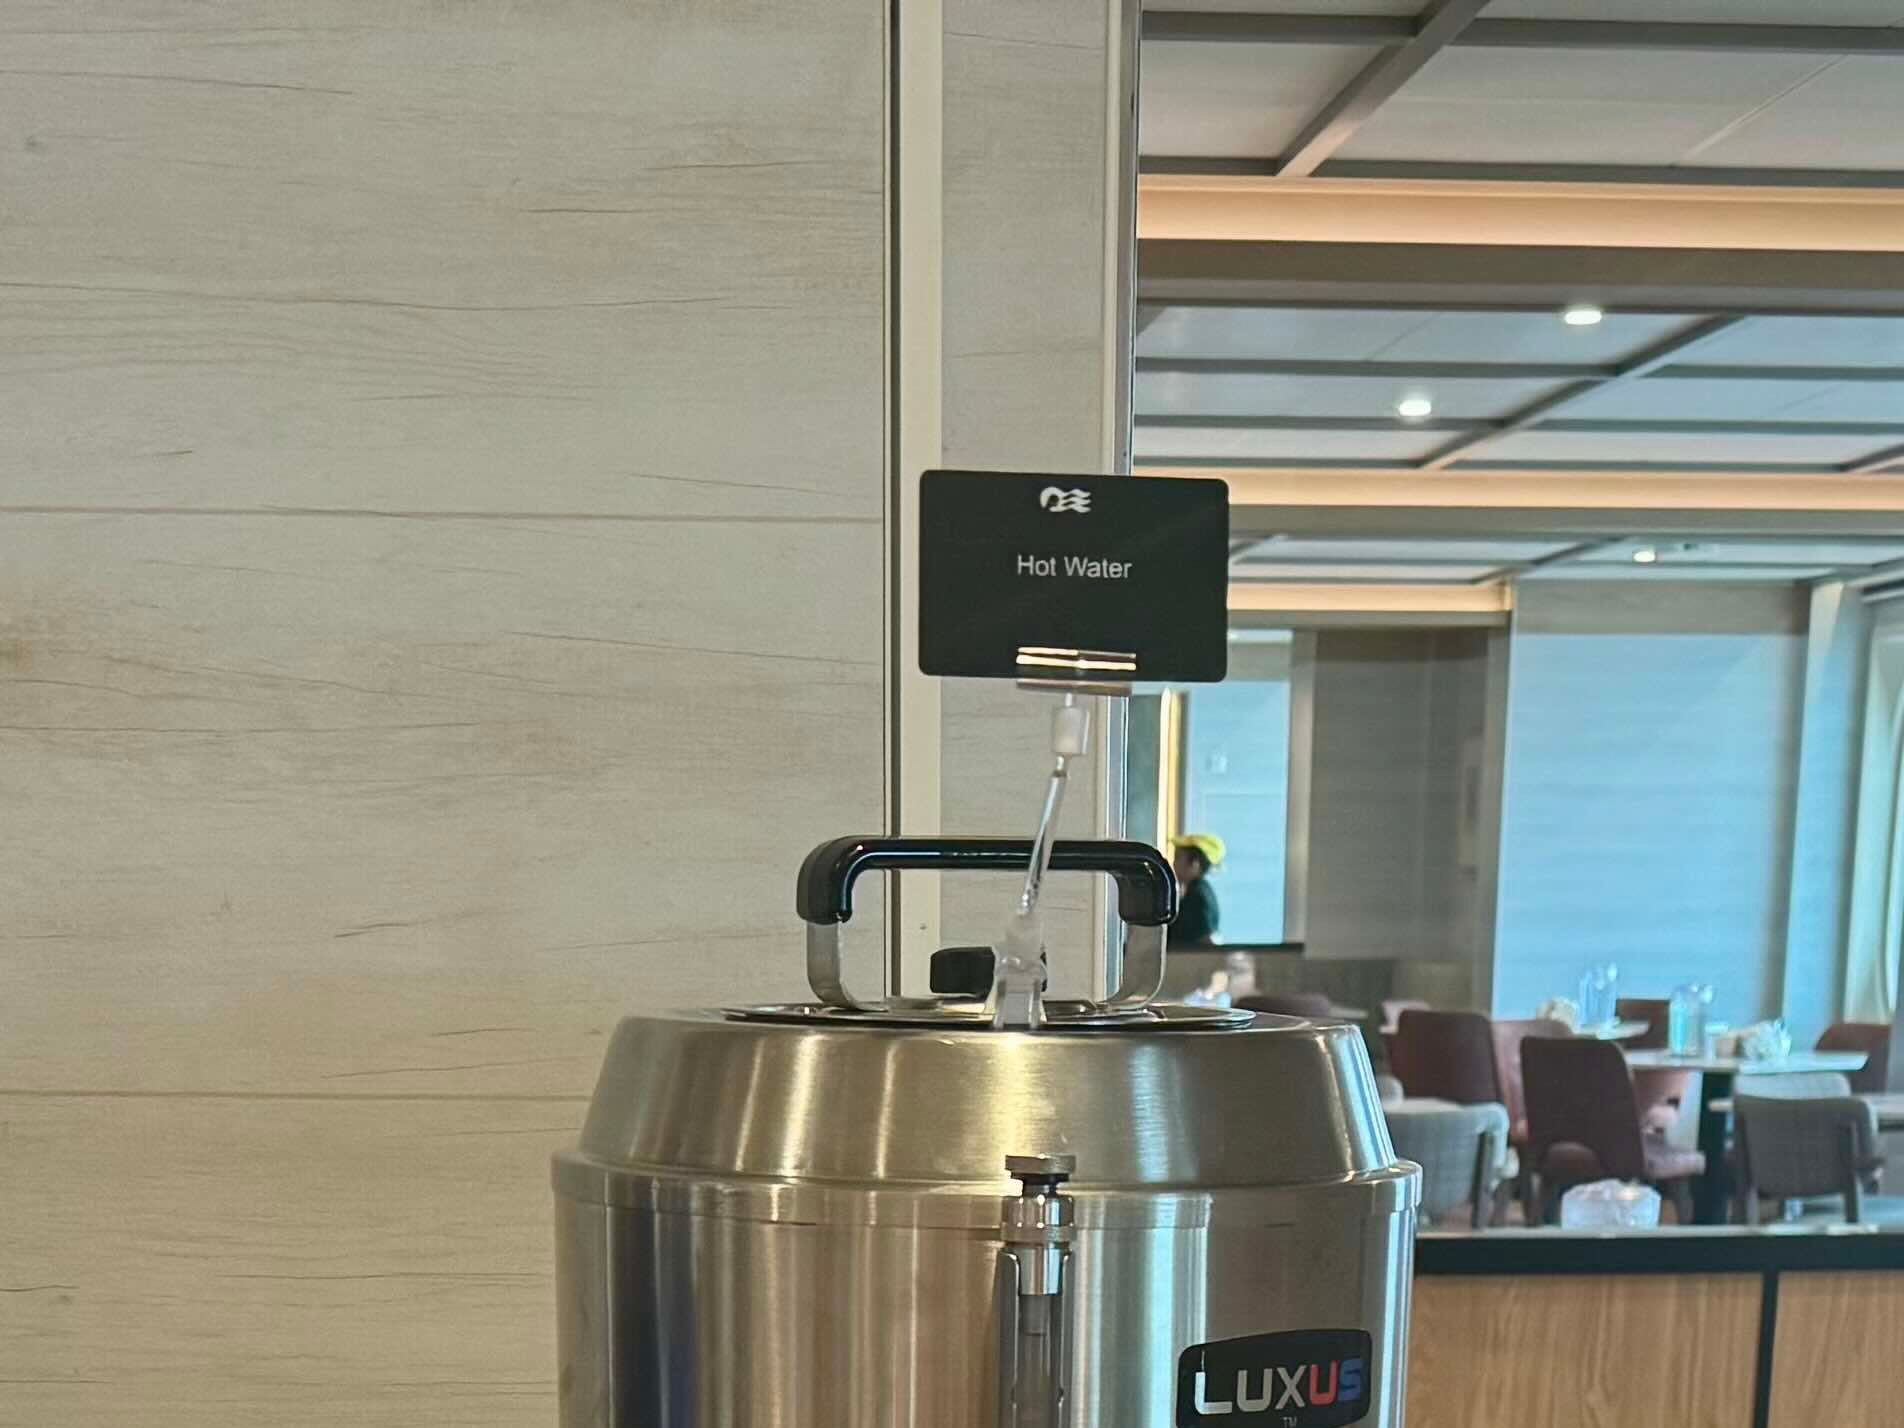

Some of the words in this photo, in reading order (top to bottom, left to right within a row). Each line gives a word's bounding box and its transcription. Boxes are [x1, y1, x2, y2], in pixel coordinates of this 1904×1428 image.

[1016, 554, 1057, 577] Hot
[1063, 556, 1132, 579] Water
[1194, 1356, 1363, 1415] LUXUS
